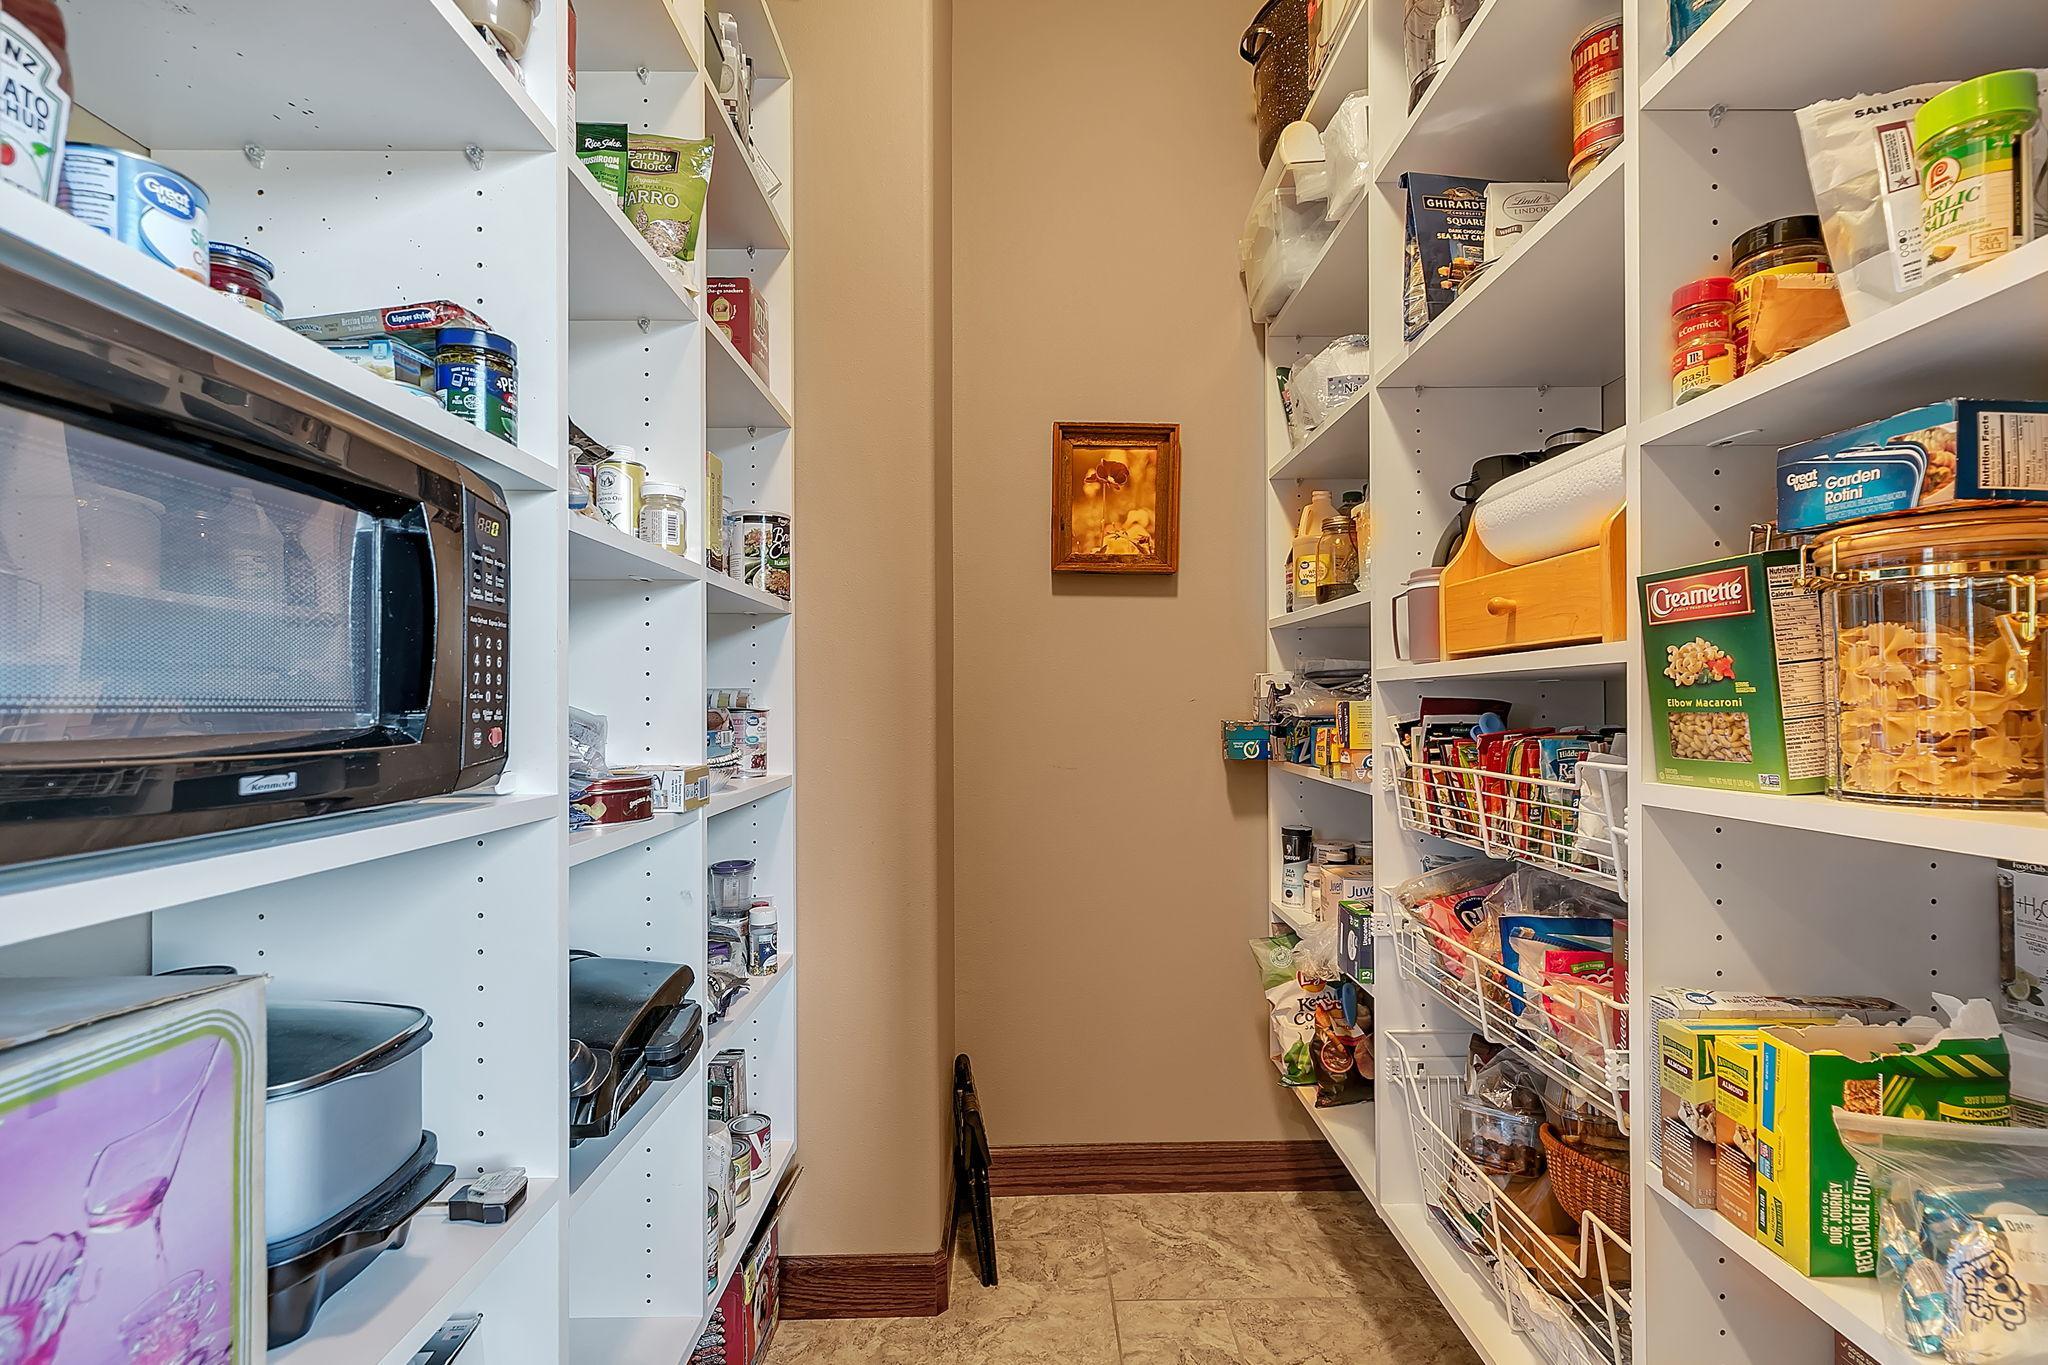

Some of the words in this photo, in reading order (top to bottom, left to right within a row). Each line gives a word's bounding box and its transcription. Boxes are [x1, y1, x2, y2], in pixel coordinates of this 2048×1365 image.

[3, 78, 49, 119] ATO
[1855, 105, 1889, 119] SAN
[584, 137, 601, 149] Rice
[628, 150, 671, 164] Earthly
[144, 177, 191, 208] Great
[625, 189, 680, 209] ARRO
[1426, 199, 1486, 210] GHIRARDE
[1511, 195, 1545, 206] Lindt
[1923, 185, 1982, 223] ARLIC
[1514, 206, 1549, 216] LINDOR
[1446, 217, 1485, 227] SQUARE
[1925, 204, 1964, 233] SALT
[1499, 226, 1518, 235] WHITE
[1979, 235, 2000, 244] SEA
[391, 314, 413, 325] kipper
[1678, 318, 1722, 338] cCormick
[1681, 366, 1709, 386] Basil
[501, 377, 517, 395] PES
[1681, 375, 1711, 393] LEAVES
[1982, 415, 1990, 441] Facts
[1982, 444, 1990, 487] Nutrition
[1787, 468, 1818, 486] Great
[1825, 468, 1881, 490] Garden
[1825, 485, 1863, 505] Rotini
[1769, 566, 1796, 575] Nutrition
[1651, 576, 1743, 617] Creamette
[474, 636, 479, 647] 1
[486, 637, 491, 649] 2
[497, 639, 502, 650] 3
[474, 654, 479, 667] 4
[486, 655, 491, 667] 5
[497, 656, 502, 668] 6
[474, 673, 480, 685] 7
[486, 673, 491, 685] 8
[497, 674, 502, 685] 9
[486, 691, 491, 702] 0
[1667, 698, 1693, 707] Elbow
[1695, 697, 1743, 707] Macaroni
[1559, 749, 1580, 758] Hidde
[251, 780, 294, 791] Kenmore
[2012, 862, 2029, 873] Food
[1347, 886, 1374, 899] Juve
[1361, 970, 1371, 980] 13
[1667, 1058, 1688, 1074] ALMOND
[1722, 1080, 1744, 1097] ALMOND
[1960, 1108, 2010, 1119] CRUNCHY
[1822, 1192, 1829, 1203] ON
[1829, 1182, 1843, 1224] JOURNEY
[1822, 1205, 1829, 1216] US
[1829, 1226, 1843, 1245] OUR
[1844, 1225, 1851, 1235] TO
[1851, 1203, 1875, 1274] RECYCLABLE
